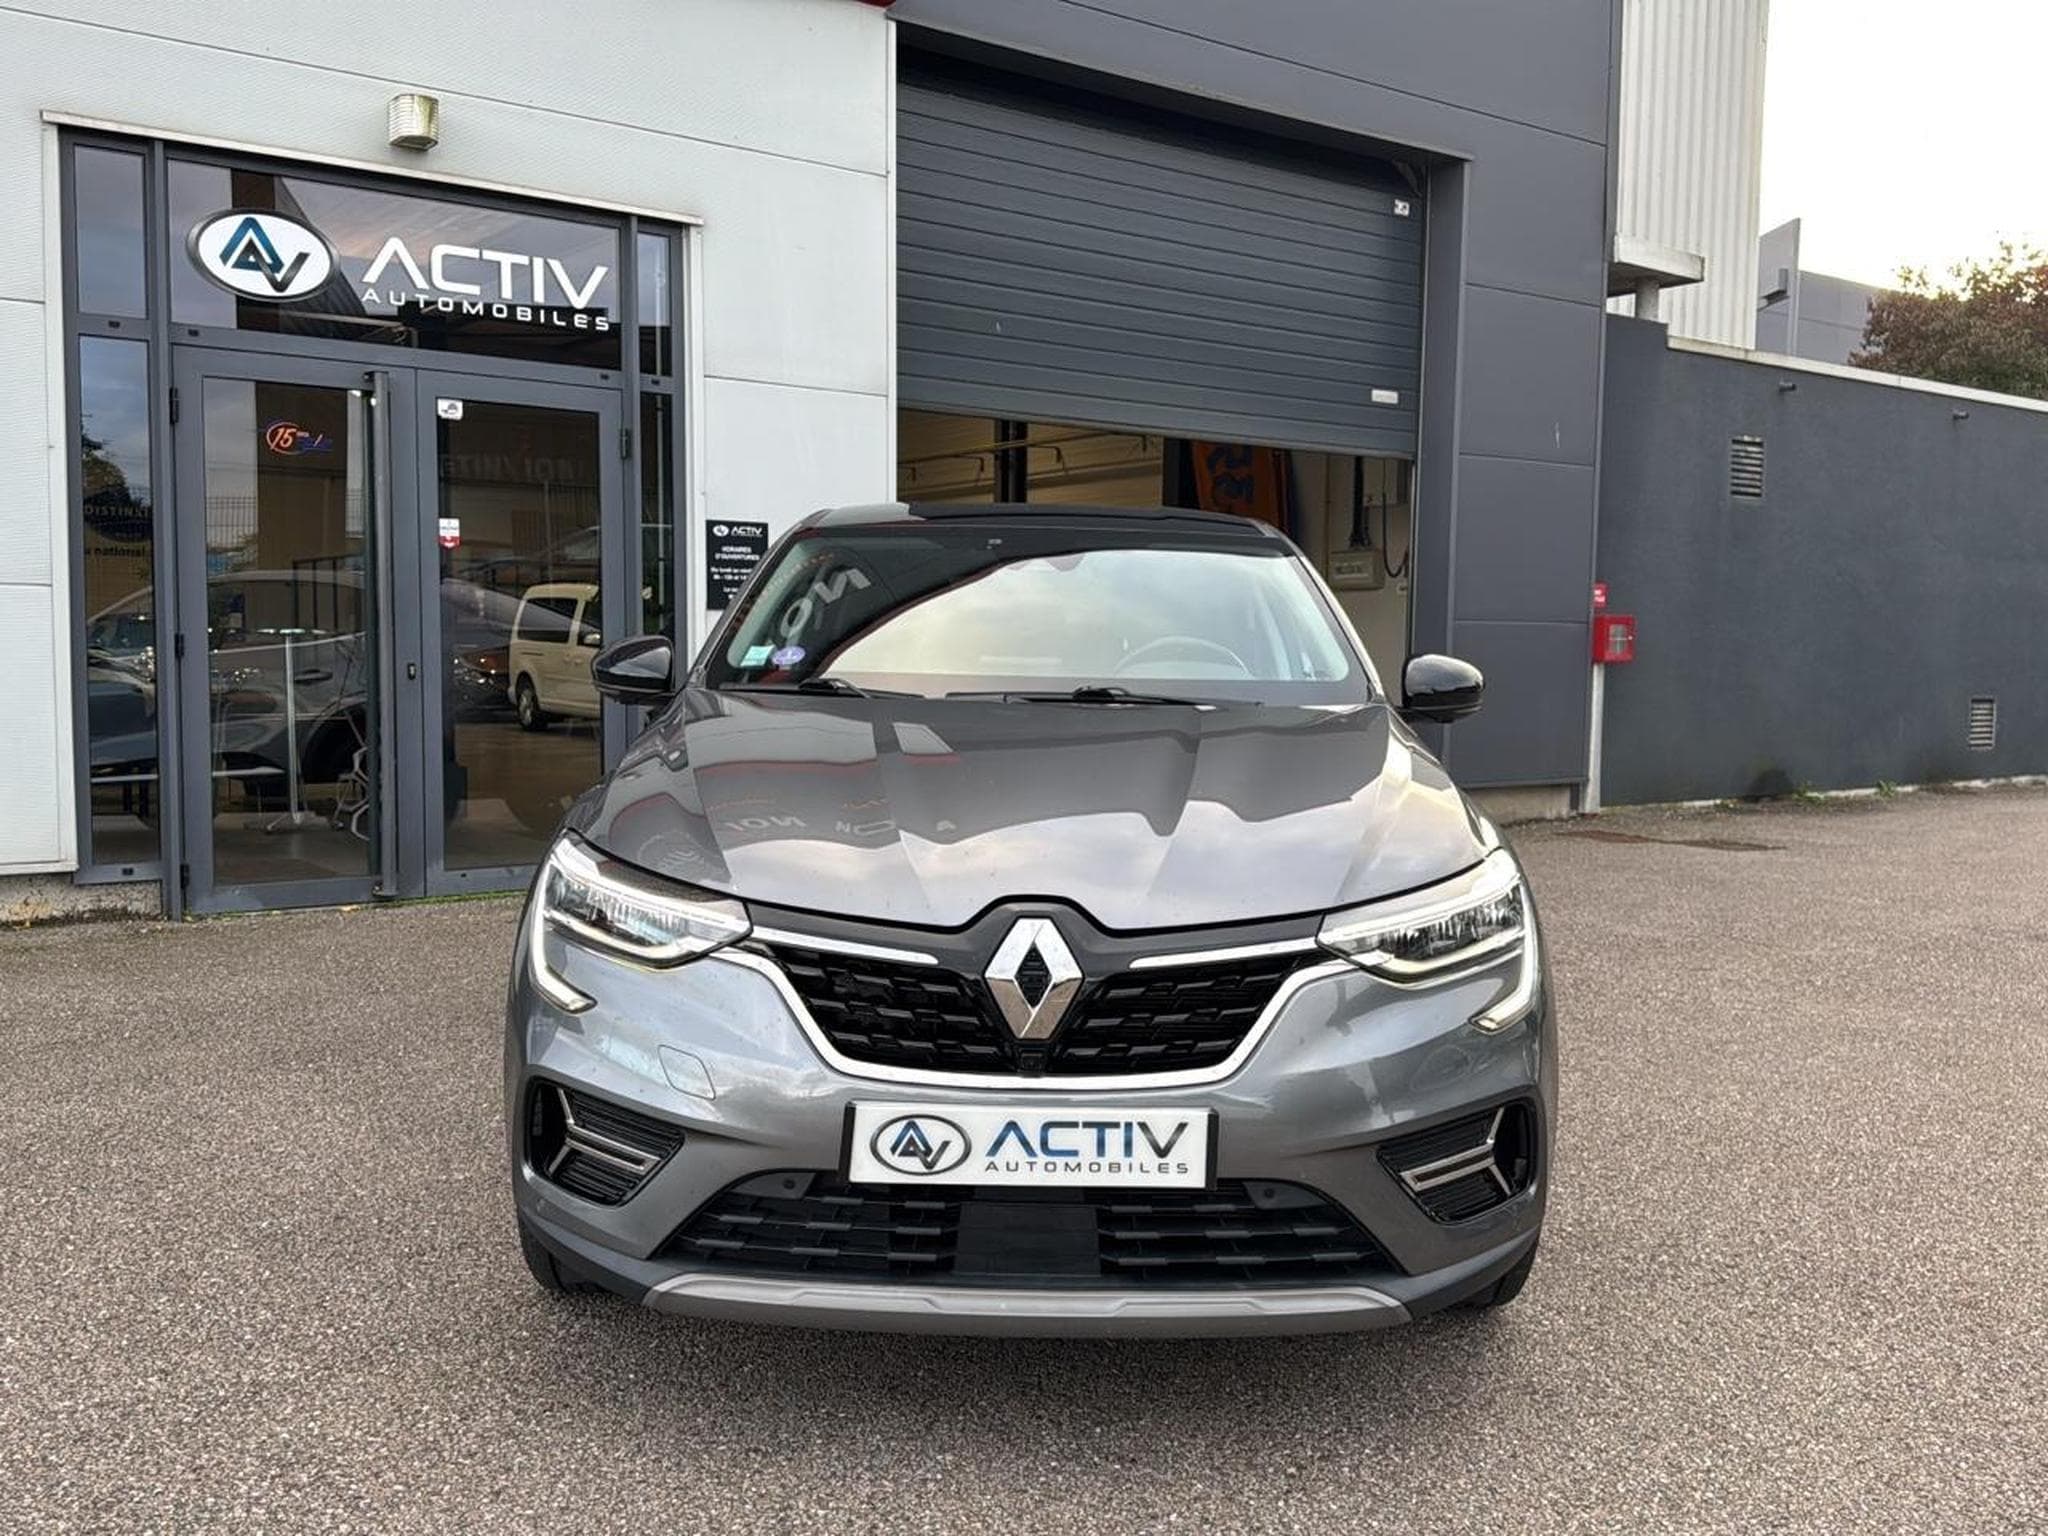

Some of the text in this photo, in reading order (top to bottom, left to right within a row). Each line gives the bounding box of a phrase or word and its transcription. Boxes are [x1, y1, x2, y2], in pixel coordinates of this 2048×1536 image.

[361, 236, 609, 309] ACTIV
[361, 289, 610, 331] AUTOMOBILES
[731, 526, 762, 535] ACTIV
[985, 1120, 1189, 1158] ACTIV
[985, 1161, 1189, 1175] AUTOMOBILES
